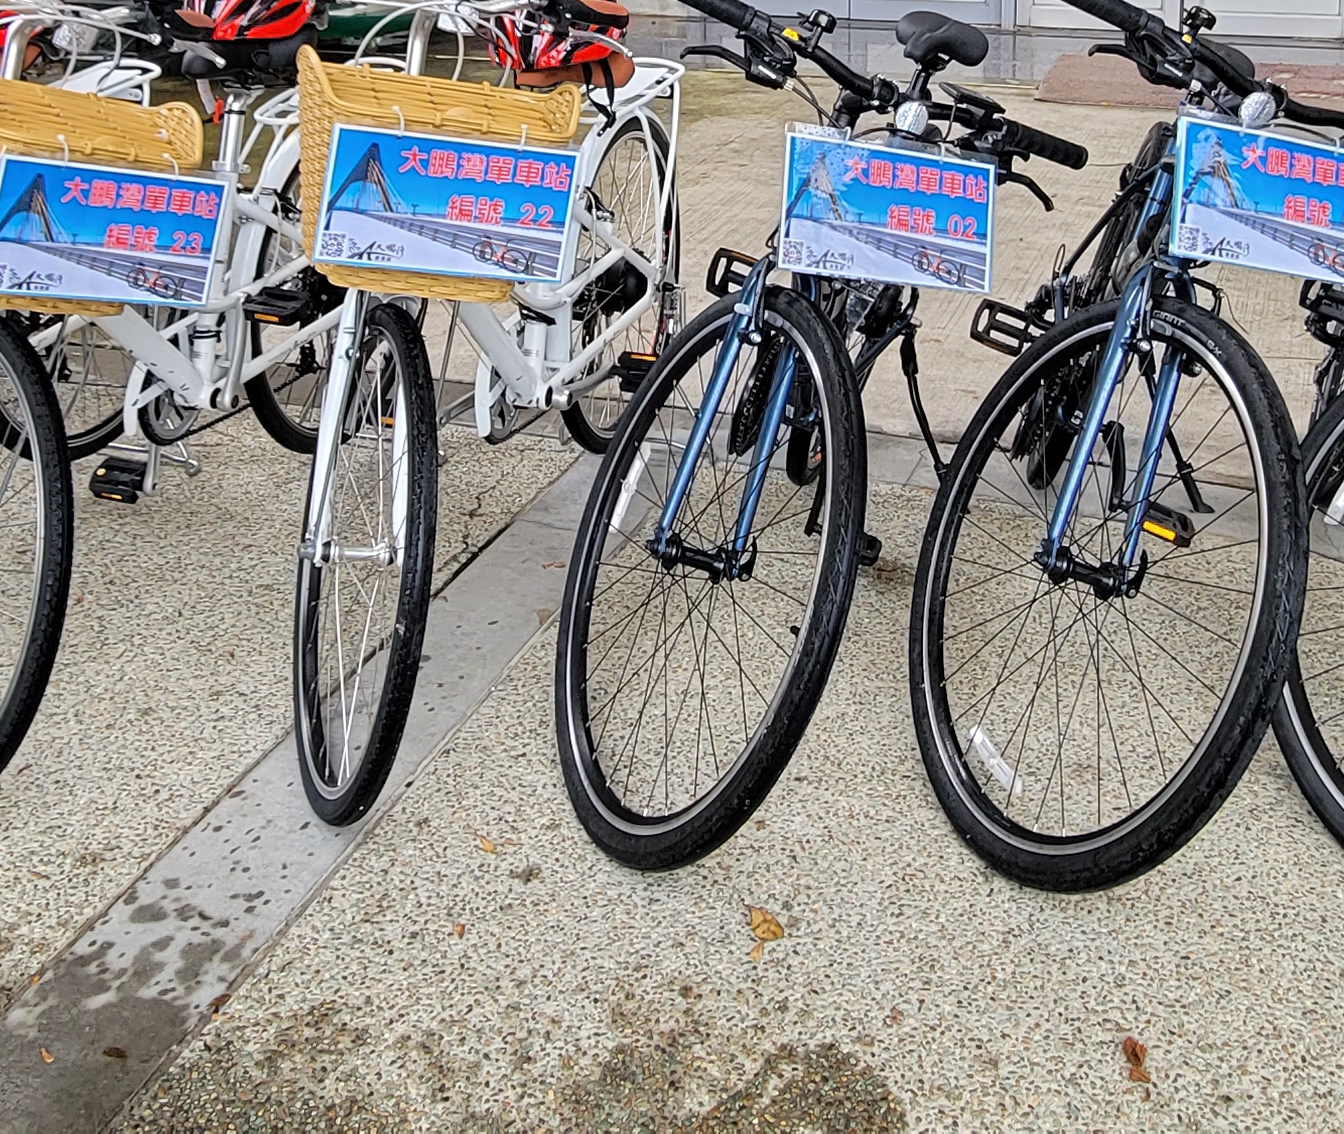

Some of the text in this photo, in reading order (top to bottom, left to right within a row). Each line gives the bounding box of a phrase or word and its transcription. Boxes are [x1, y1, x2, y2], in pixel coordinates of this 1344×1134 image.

[398, 145, 572, 192] 大鵬灣單車站
[843, 155, 987, 203] 大鵬灣單車站
[59, 176, 219, 219] 大鵬灣單車站
[445, 194, 554, 228] 編號 22
[1283, 194, 1331, 228] 編號
[104, 223, 203, 255] 編號 23
[887, 205, 977, 240] 編號 02
